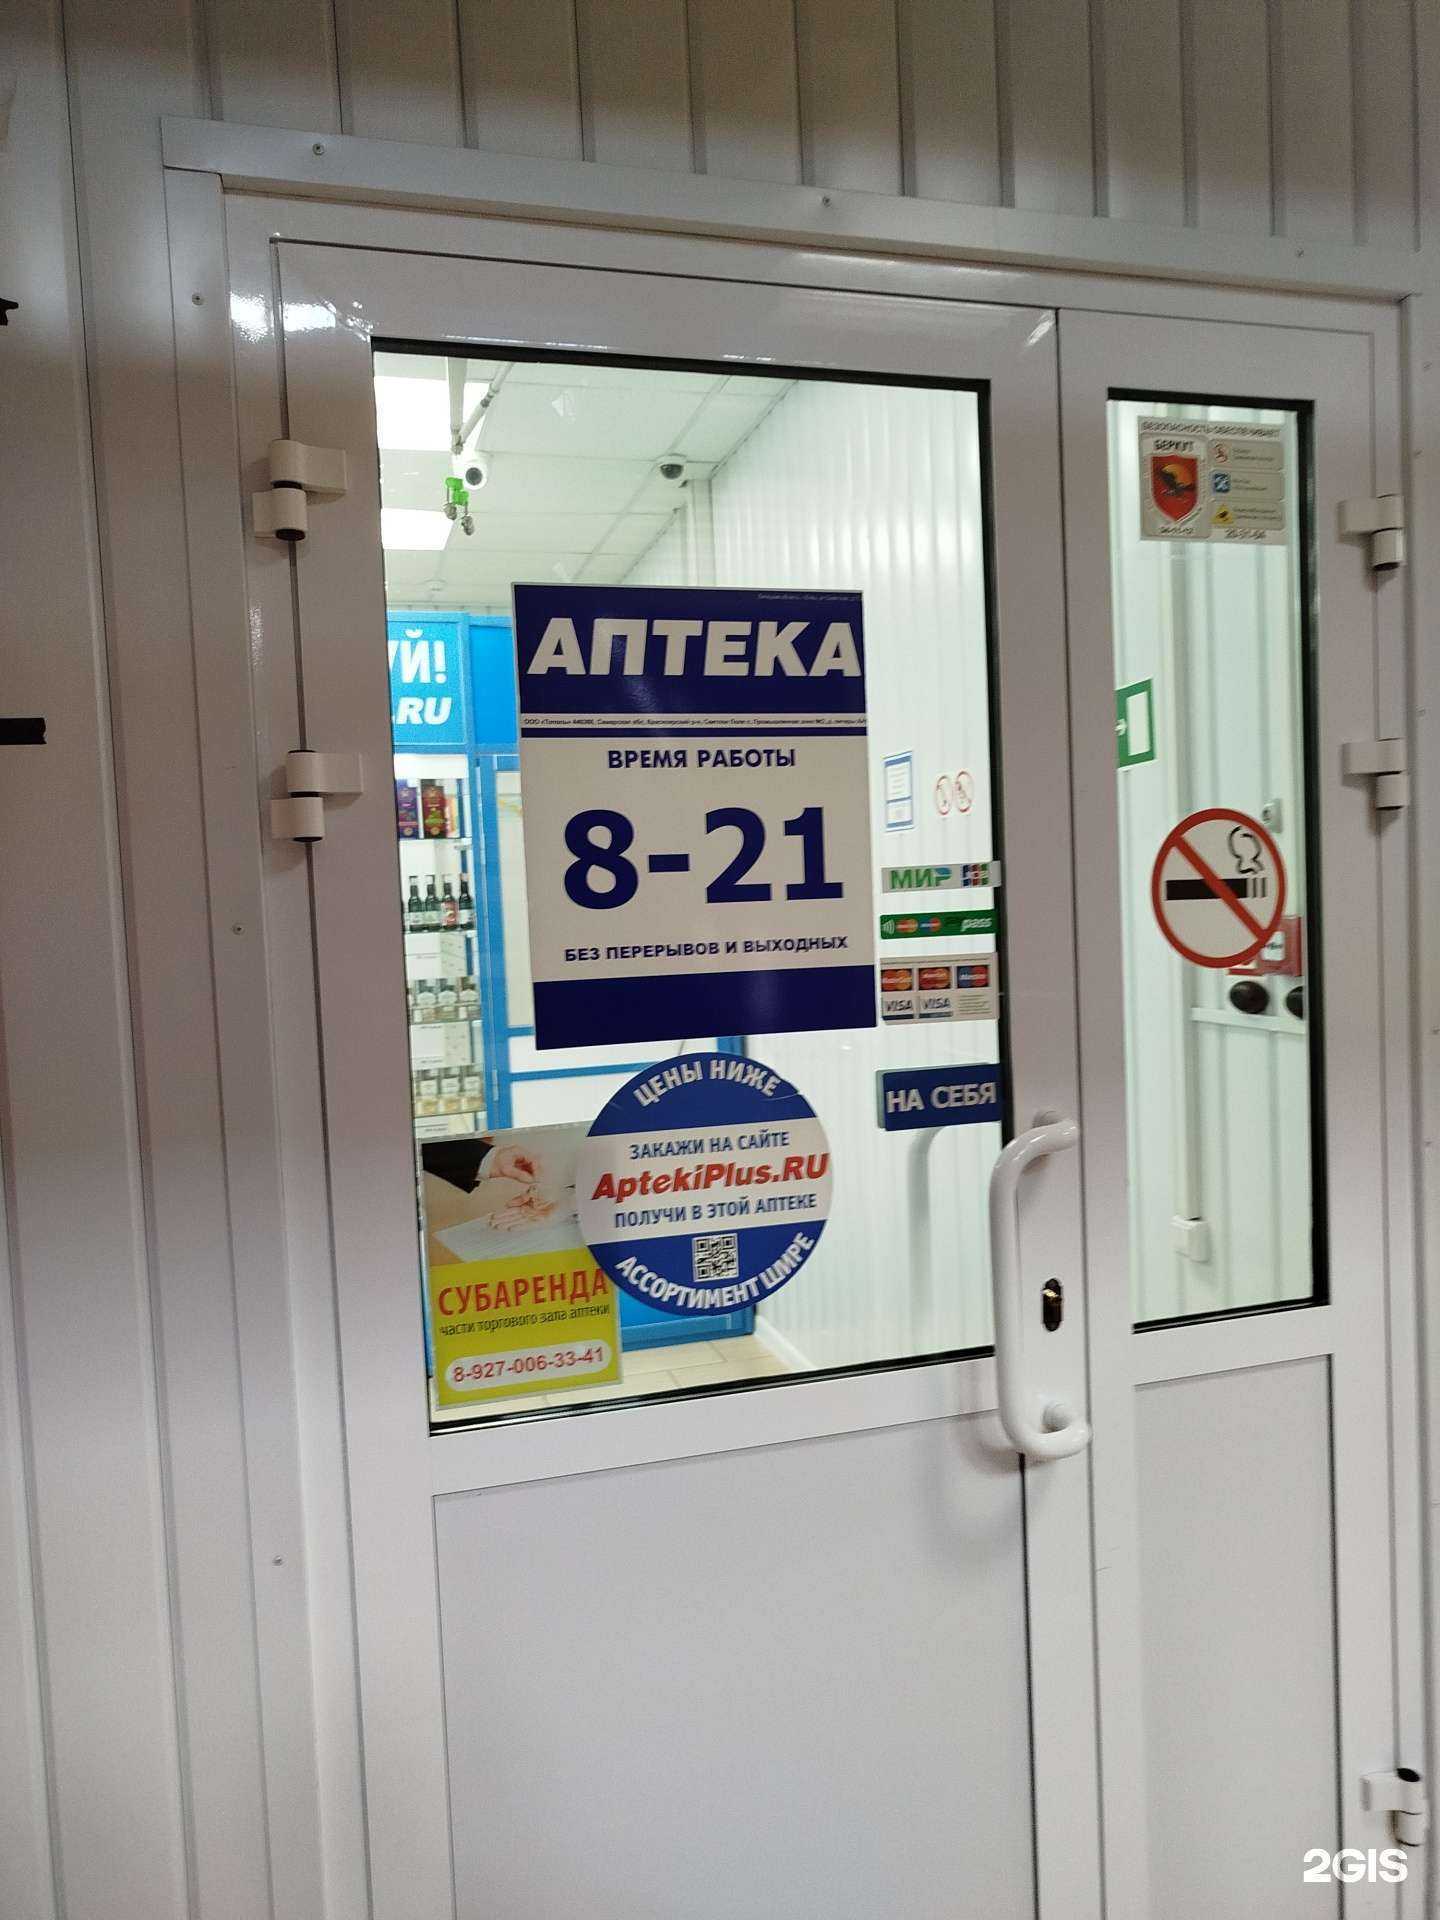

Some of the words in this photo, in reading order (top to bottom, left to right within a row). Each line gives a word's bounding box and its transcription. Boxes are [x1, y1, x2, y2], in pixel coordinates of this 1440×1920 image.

[527, 617, 862, 678] АПТЕКА
[608, 749, 688, 769] ВРЕМЯ
[697, 748, 795, 768] РАБОТЫ
[564, 806, 844, 910] 8-21
[890, 867, 952, 889] МИР
[564, 948, 601, 962] БЕЗ
[606, 940, 720, 961] ПЕРЕРЫВОВ
[726, 941, 737, 954] И
[743, 936, 849, 954] ВЫХОДНЫХ
[633, 1060, 703, 1108] ЦЕНЫ
[709, 1059, 782, 1098] НИЖЕ
[886, 1088, 925, 1113] НА
[930, 1081, 997, 1109] СЕБЯ
[629, 1137, 704, 1160] ЗАКАЖИ
[709, 1135, 733, 1153] НА
[738, 1128, 790, 1151] САЙТЕ
[591, 1152, 830, 1204] AptekiPlus.RU
[614, 1206, 687, 1229] ПОЛУЧИ
[692, 1205, 703, 1221] В
[707, 1196, 750, 1219] ЭТОЙ
[754, 1193, 818, 1215] АПТЕКЕ
[616, 1255, 760, 1310] АССОРТИМЕНТ
[760, 1231, 815, 1289] ШИРЕ
[438, 1267, 609, 1317] СУБАРЕНДА
[440, 1322, 475, 1337] части
[477, 1314, 538, 1335] торгового
[539, 1309, 567, 1323] зала
[570, 1303, 611, 1319] аптеки
[453, 1346, 604, 1383] 8-927-006-33-41
